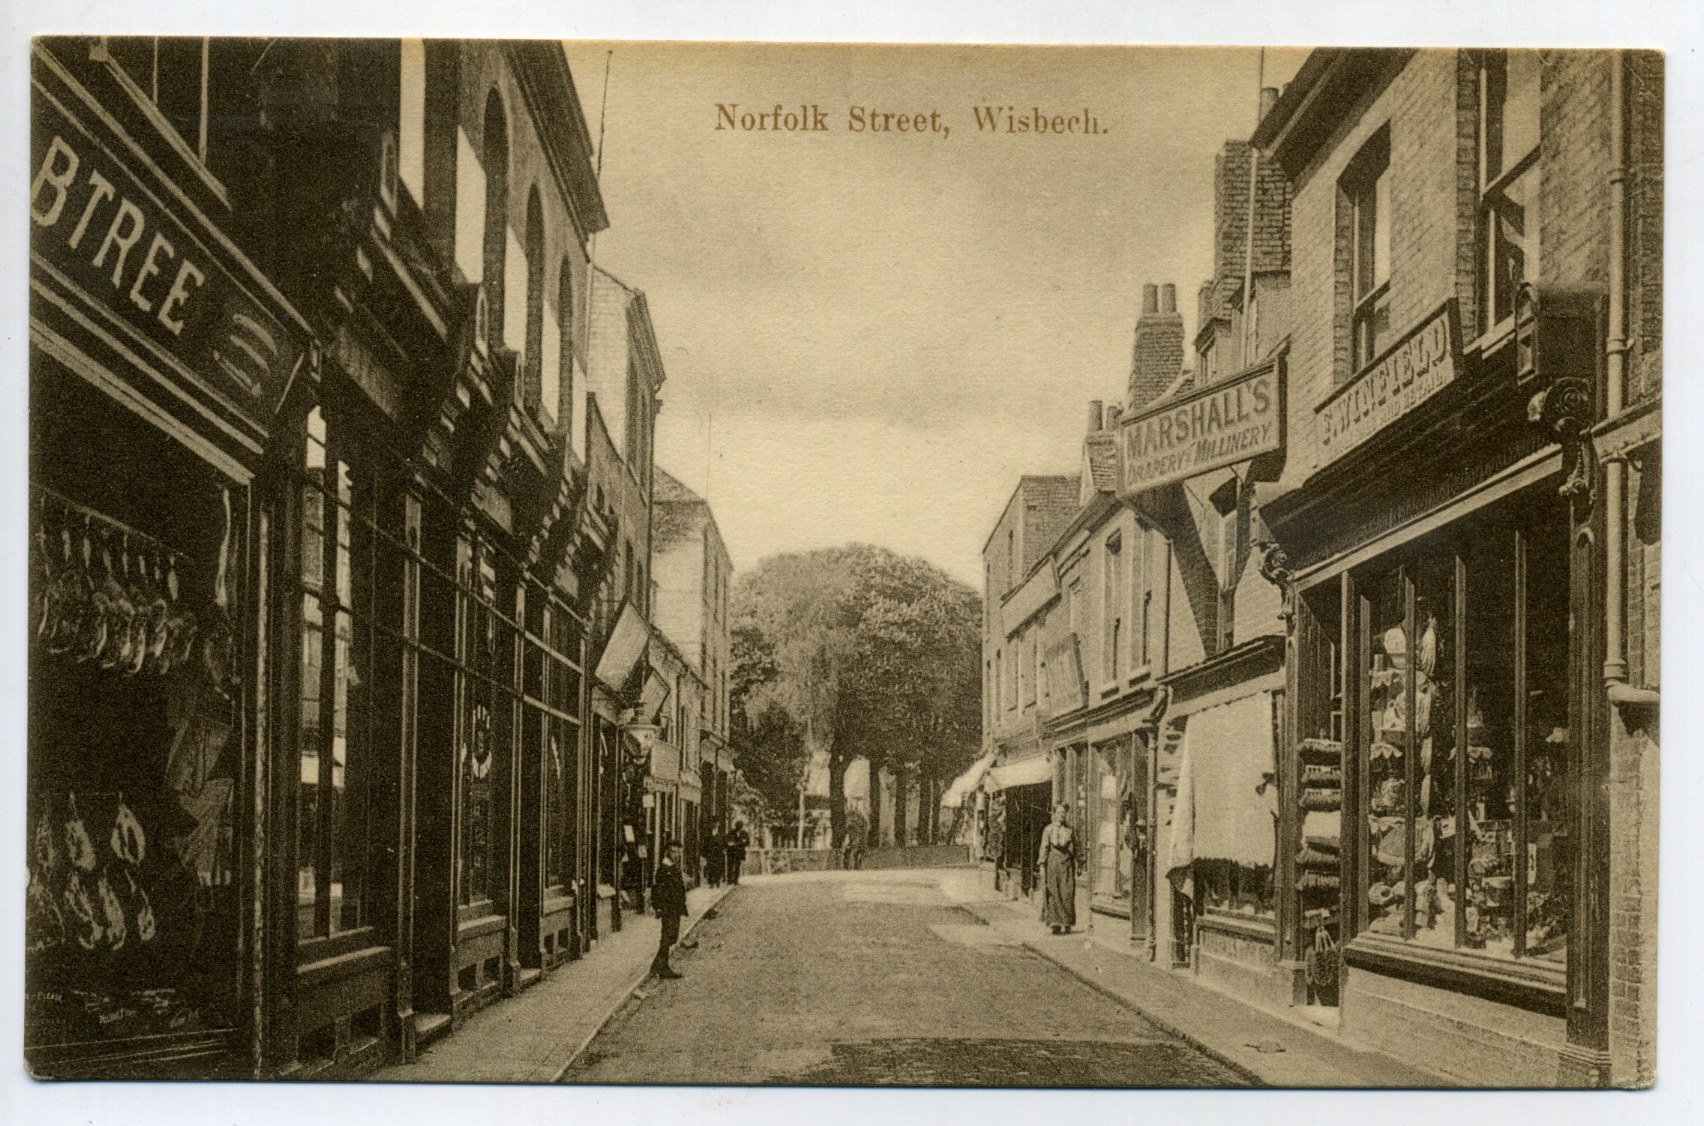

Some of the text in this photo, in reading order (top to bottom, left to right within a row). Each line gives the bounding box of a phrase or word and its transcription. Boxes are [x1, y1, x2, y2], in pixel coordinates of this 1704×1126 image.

[30, 135, 205, 336] BTREE
[1127, 378, 1272, 460] MARSHALL'S
[1127, 451, 1185, 487] DRAPERY
